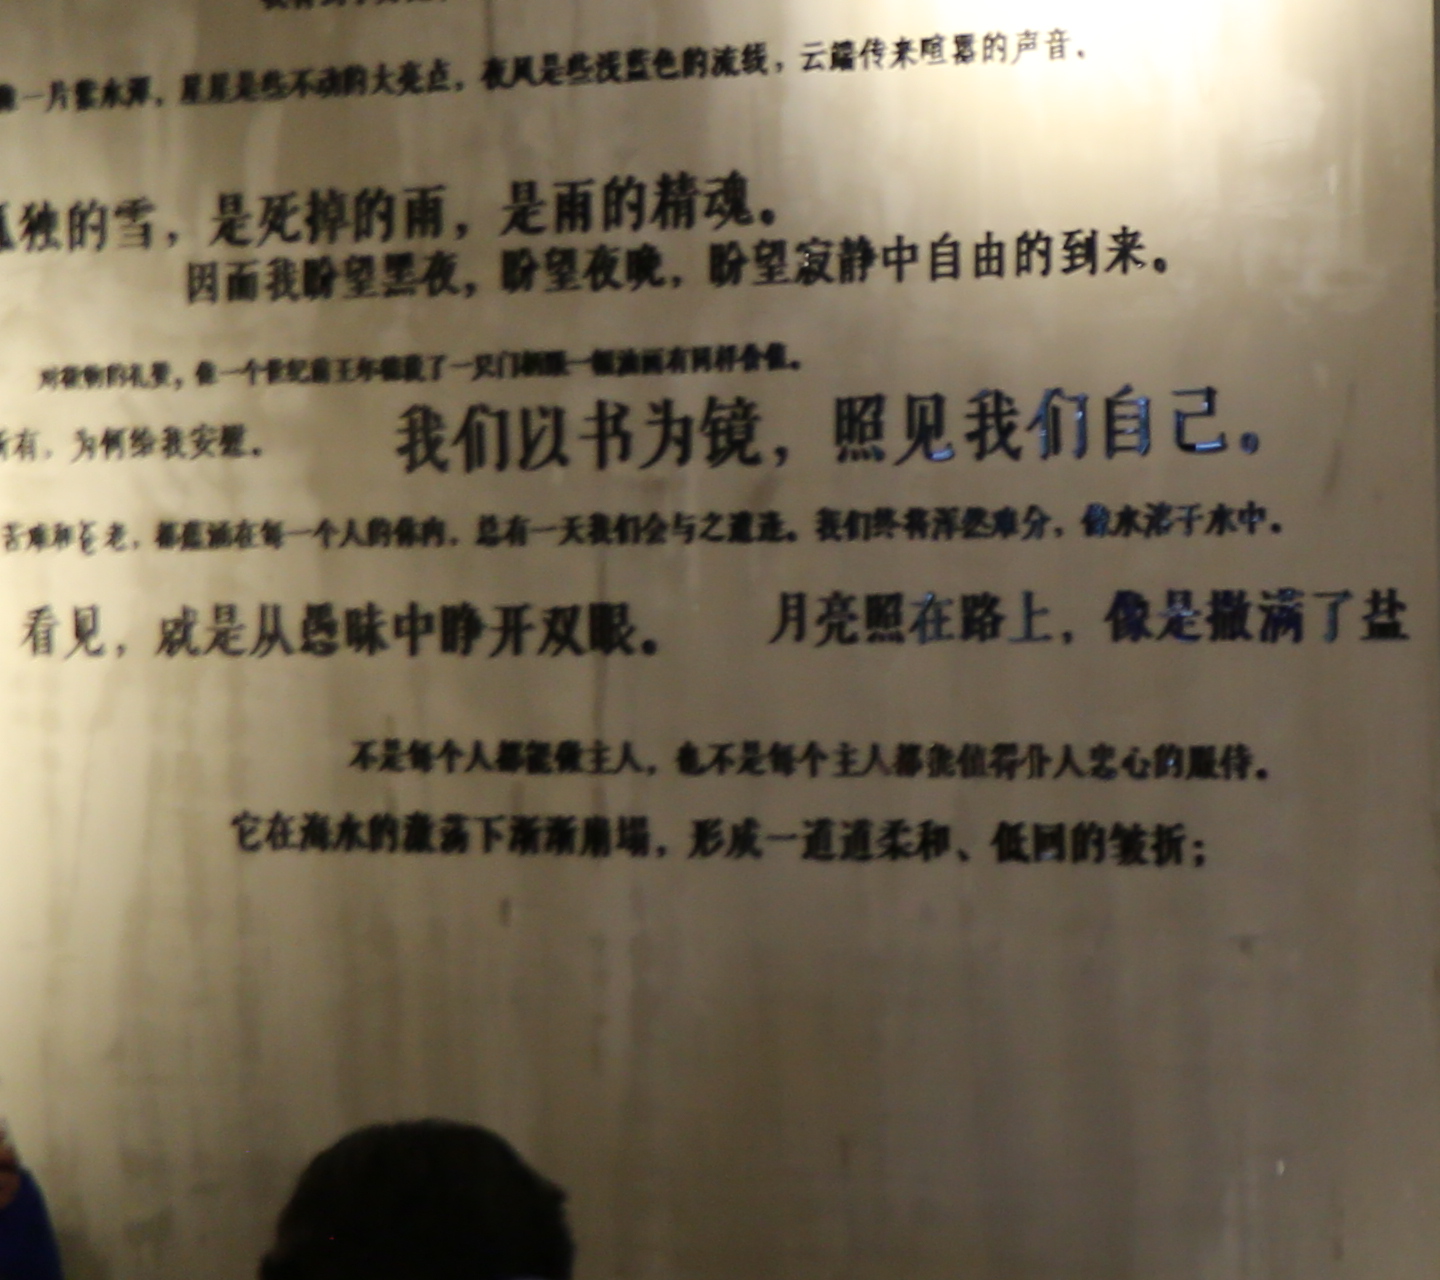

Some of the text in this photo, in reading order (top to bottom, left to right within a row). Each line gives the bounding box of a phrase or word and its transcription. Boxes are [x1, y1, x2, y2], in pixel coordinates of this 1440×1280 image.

[396, 387, 1260, 472] 我们以书为镜，照见我们自己。
[20, 588, 1409, 660] 看见，就是从愚昧中睁开双眼。 月亮照在路上，像是撒满了盐
